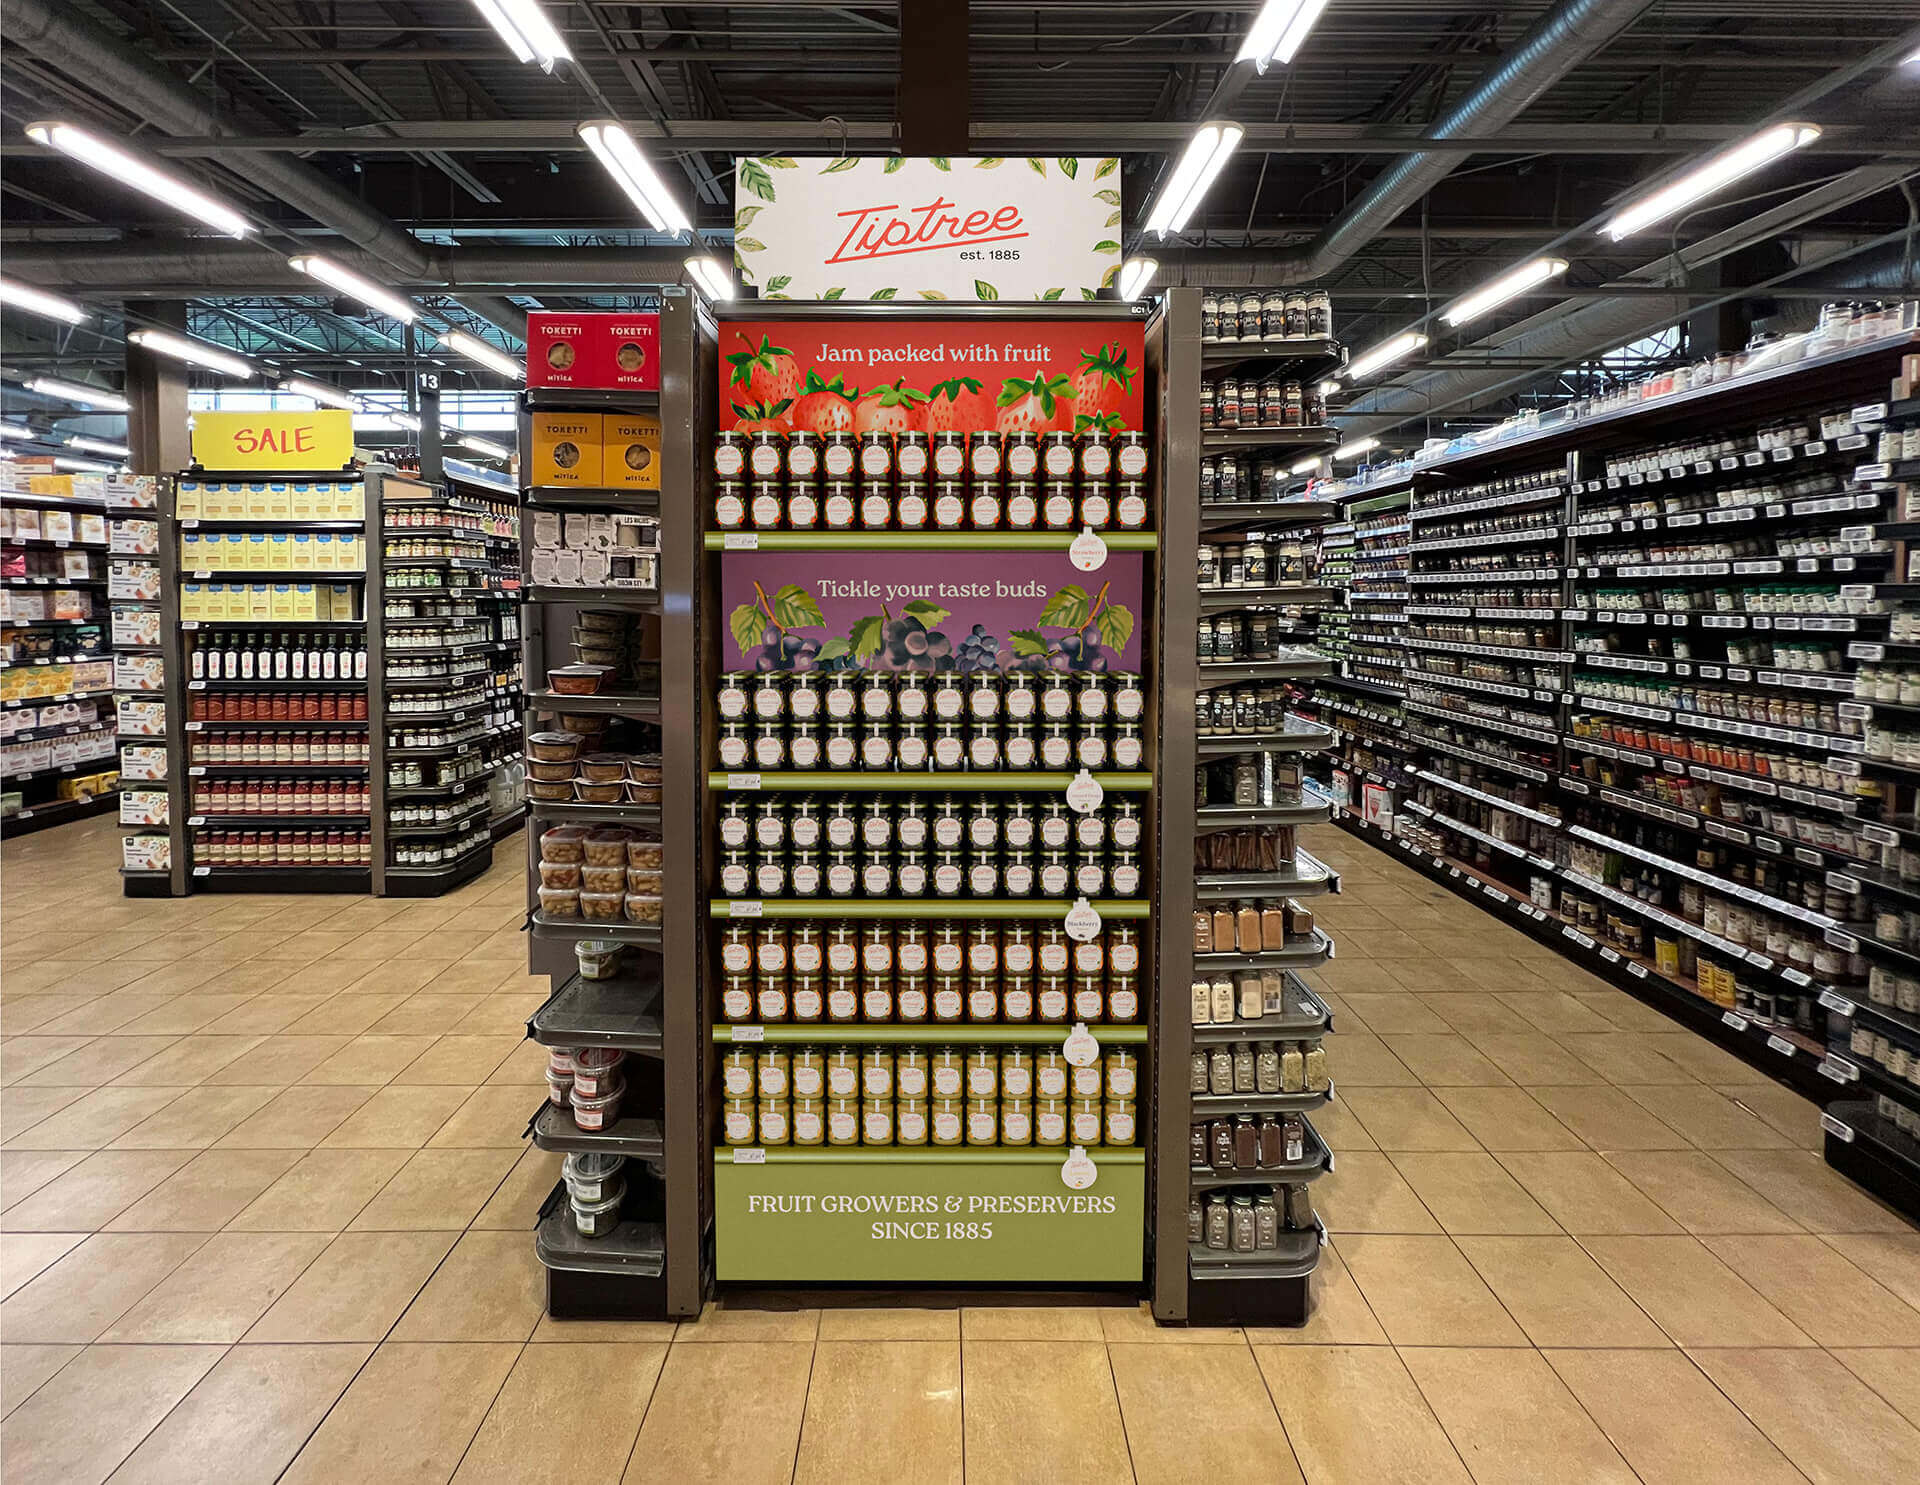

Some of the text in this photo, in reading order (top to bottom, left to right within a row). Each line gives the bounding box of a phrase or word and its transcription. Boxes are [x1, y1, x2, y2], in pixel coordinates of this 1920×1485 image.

[825, 196, 1029, 264] Tiptree
[960, 250, 1020, 260] est. 1885
[541, 326, 582, 335] TOKETTI
[610, 327, 652, 336] TOKETTI
[816, 343, 1051, 366] Jam packed with fruit
[419, 373, 438, 389] 13
[546, 425, 588, 434] TOKETTI
[617, 427, 660, 436] TOKETTI
[234, 427, 316, 455] SALE
[817, 580, 1047, 602] Tickle your taste buds
[748, 1195, 1116, 1213] FRUIT GROWERS & PRESERVERS
[871, 1222, 993, 1240] SINCE 1885
